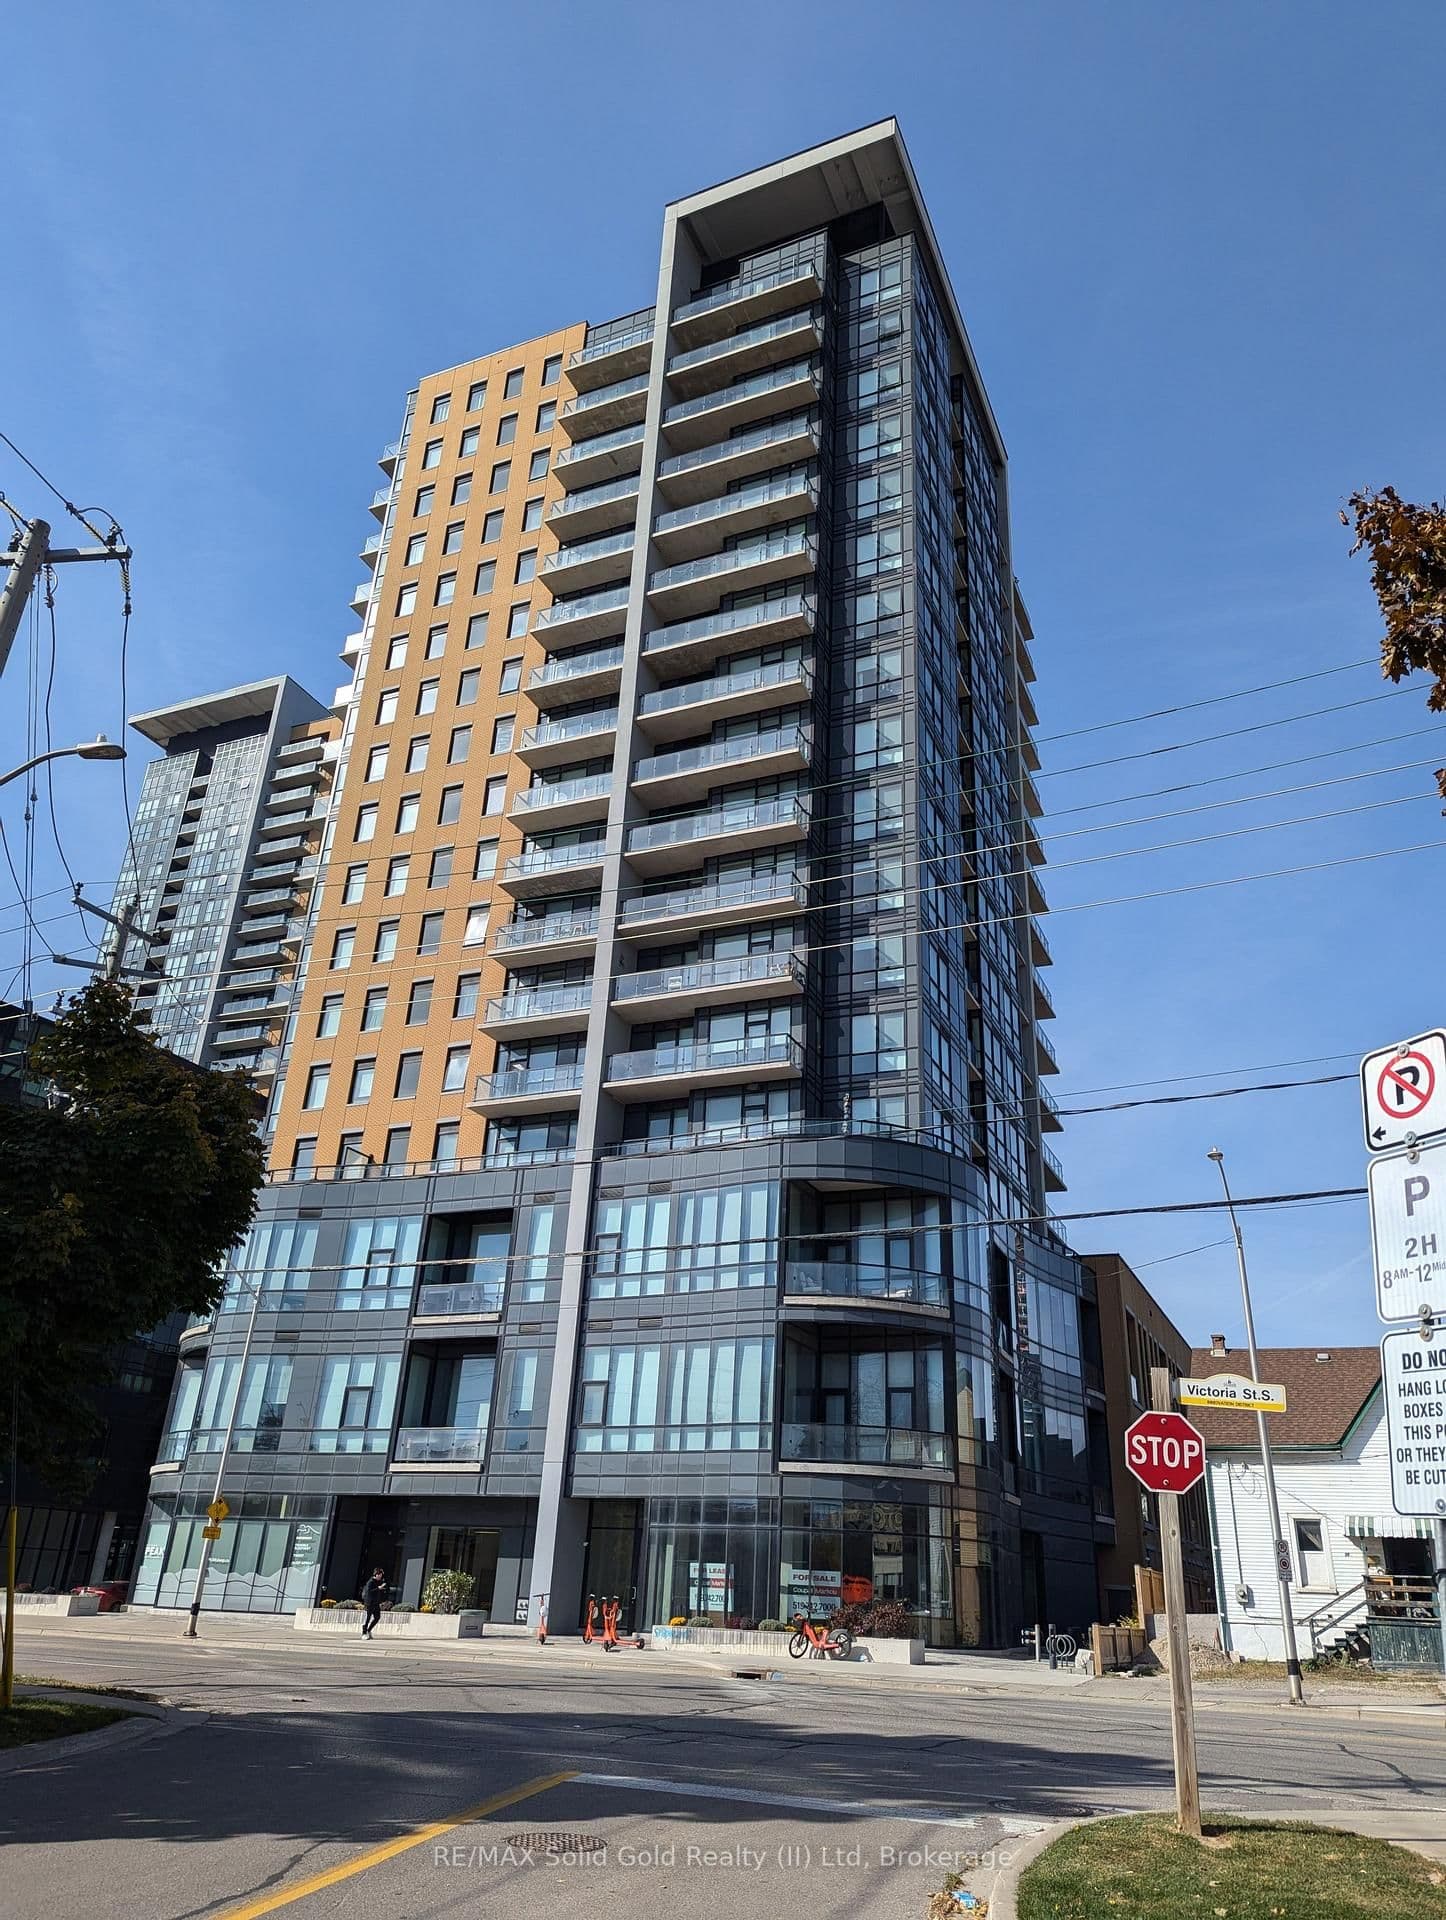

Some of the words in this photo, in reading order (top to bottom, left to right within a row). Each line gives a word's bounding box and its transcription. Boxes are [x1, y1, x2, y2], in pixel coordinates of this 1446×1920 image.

[1404, 1175, 1430, 1217] P
[1402, 1352, 1422, 1370] DO
[1428, 1348, 1446, 1367] NO
[1187, 1384, 1236, 1398] Victoria
[1398, 1381, 1431, 1397] HANG
[1404, 1402, 1443, 1418] BOXES
[1404, 1425, 1431, 1440] THIS
[1436, 1424, 1446, 1439] P
[1131, 1434, 1200, 1469] STOP
[1397, 1447, 1412, 1463] OR
[1416, 1446, 1445, 1462] THEY
[1406, 1469, 1420, 1485] BE
[1424, 1469, 1446, 1485] CUT
